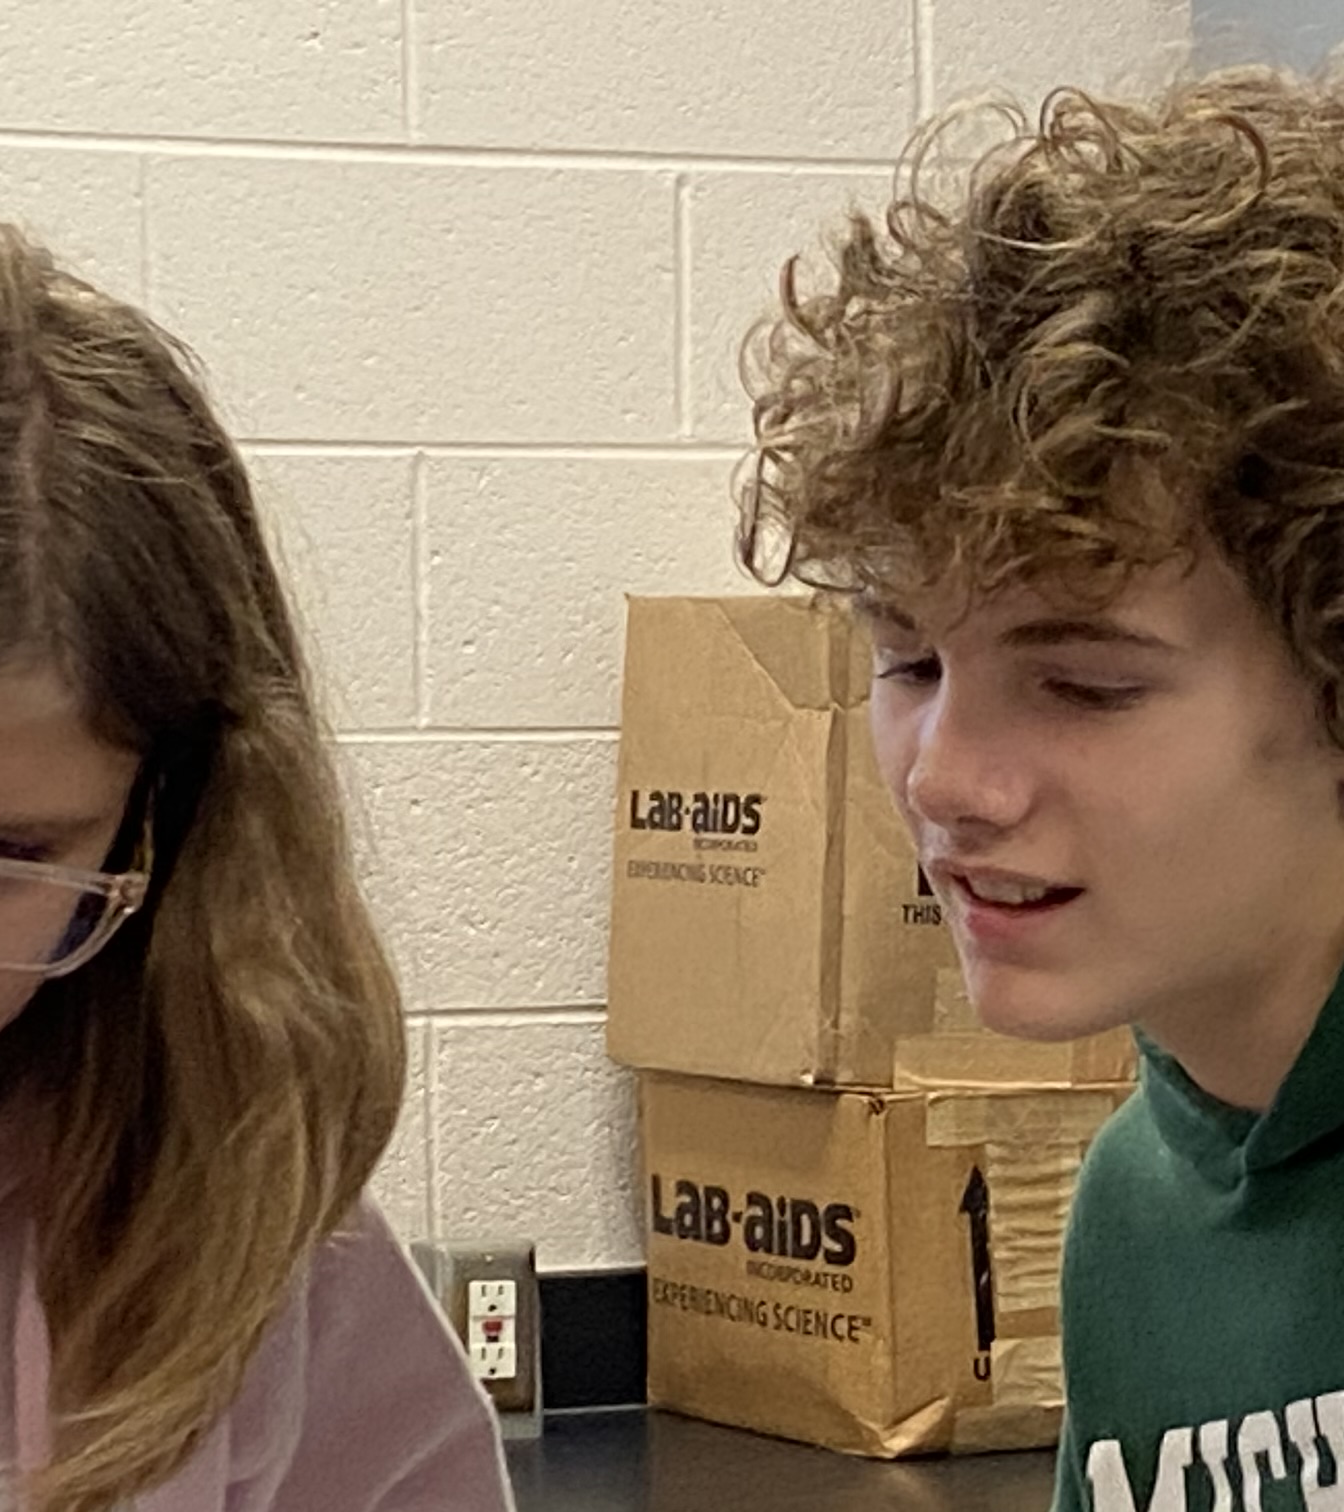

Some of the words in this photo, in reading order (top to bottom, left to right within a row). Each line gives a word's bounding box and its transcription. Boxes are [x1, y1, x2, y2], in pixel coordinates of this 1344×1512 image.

[902, 903, 942, 926] THIS
[746, 1260, 853, 1293] INCORPORATED
[652, 1277, 768, 1327] EXPERIENCING
[973, 1356, 991, 1382] U
